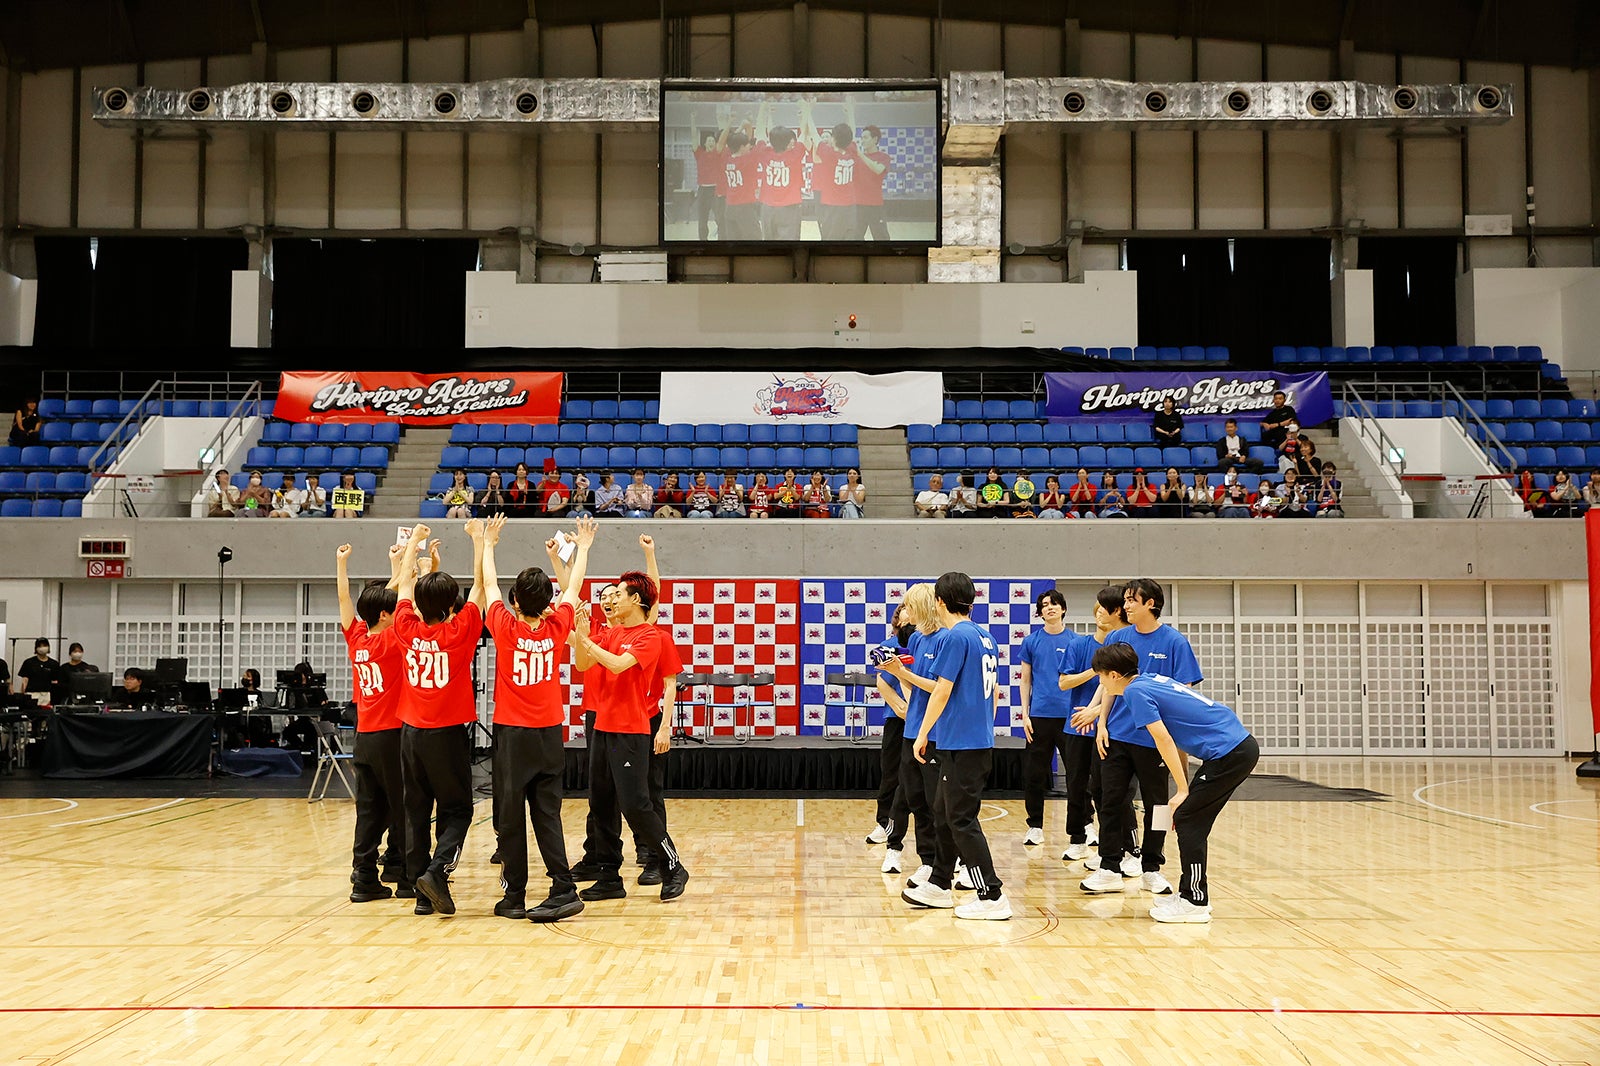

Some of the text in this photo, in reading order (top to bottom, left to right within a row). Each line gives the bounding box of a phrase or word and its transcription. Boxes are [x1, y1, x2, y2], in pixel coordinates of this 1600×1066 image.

[312, 378, 511, 409] Horipro Actors
[386, 390, 527, 416] Sports Festival
[1082, 377, 1275, 410] Horipro Actors
[334, 491, 362, 506] 西野
[406, 648, 450, 689] 520
[512, 650, 554, 686] 501
